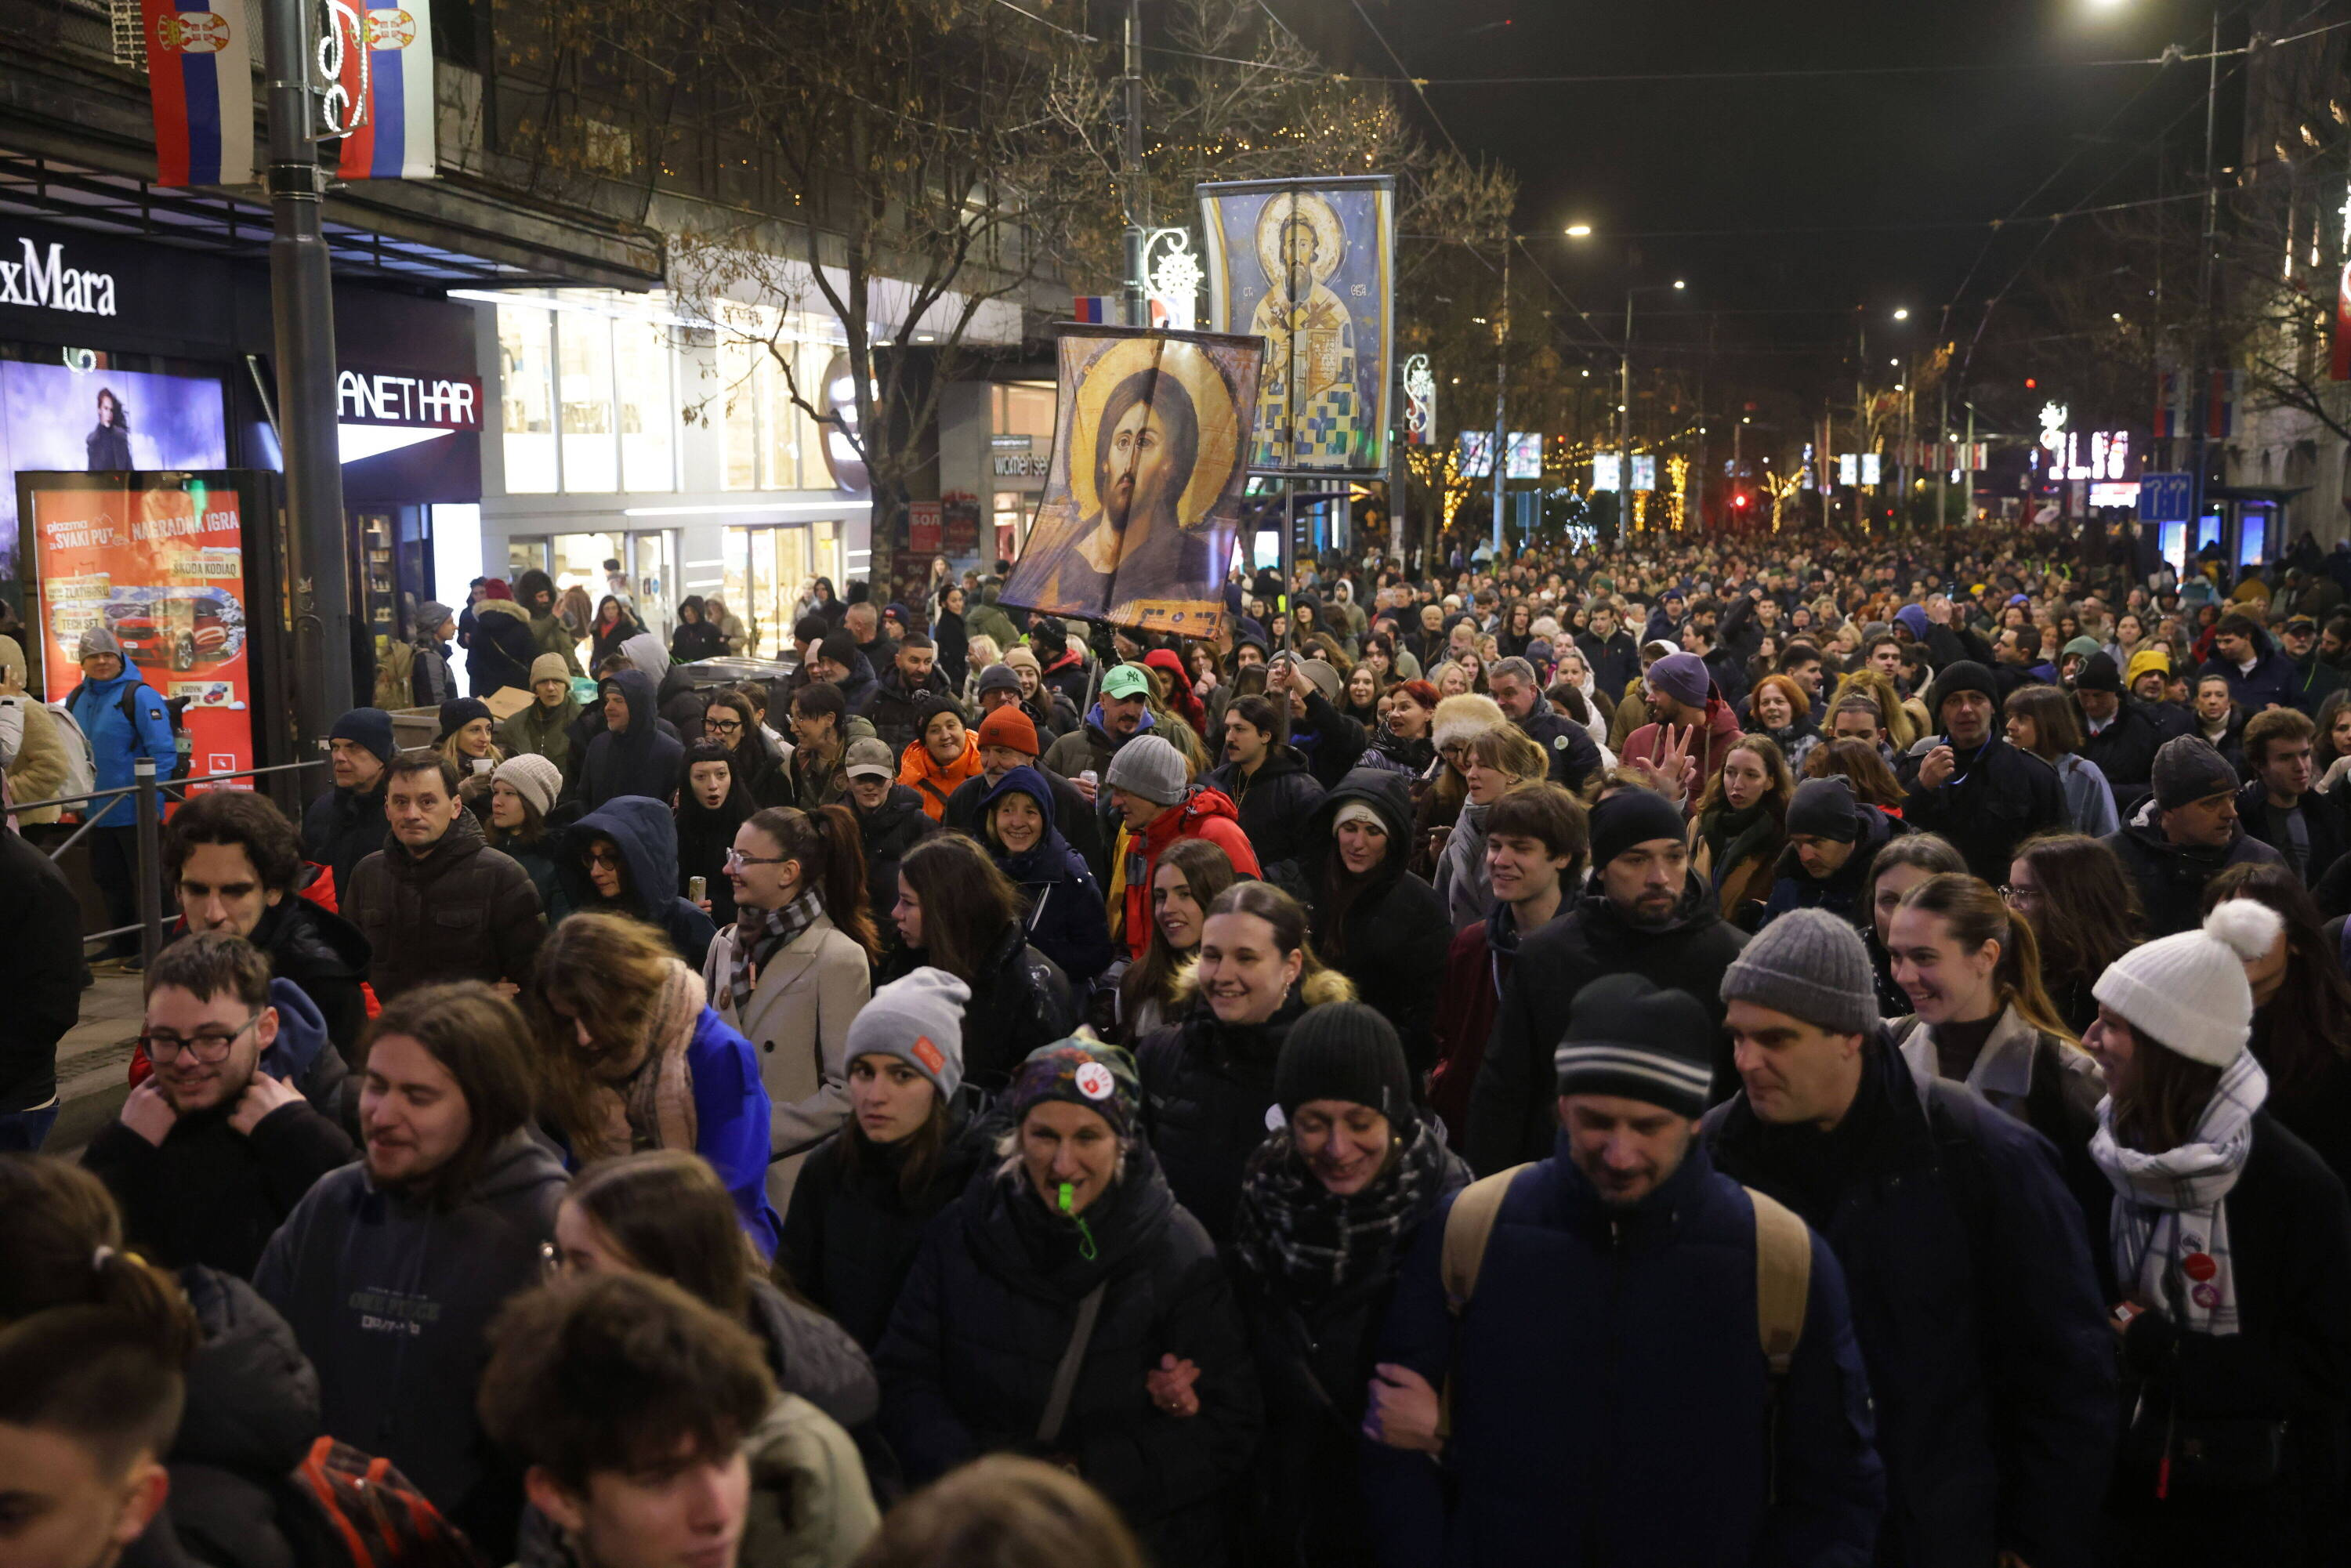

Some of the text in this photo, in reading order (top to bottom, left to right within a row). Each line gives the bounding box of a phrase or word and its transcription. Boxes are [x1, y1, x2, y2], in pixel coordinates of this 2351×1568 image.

[337, 371, 415, 420] ANET
[994, 454, 1049, 476] women'se
[46, 520, 89, 536] plazma
[131, 510, 240, 541] NAGRADNA IGRA
[55, 531, 90, 549] SVAKI
[91, 527, 114, 545] PUT
[204, 562, 237, 578] KODIAQ
[60, 617, 100, 630] TECH SET
[1126, 670, 1139, 683] NY
